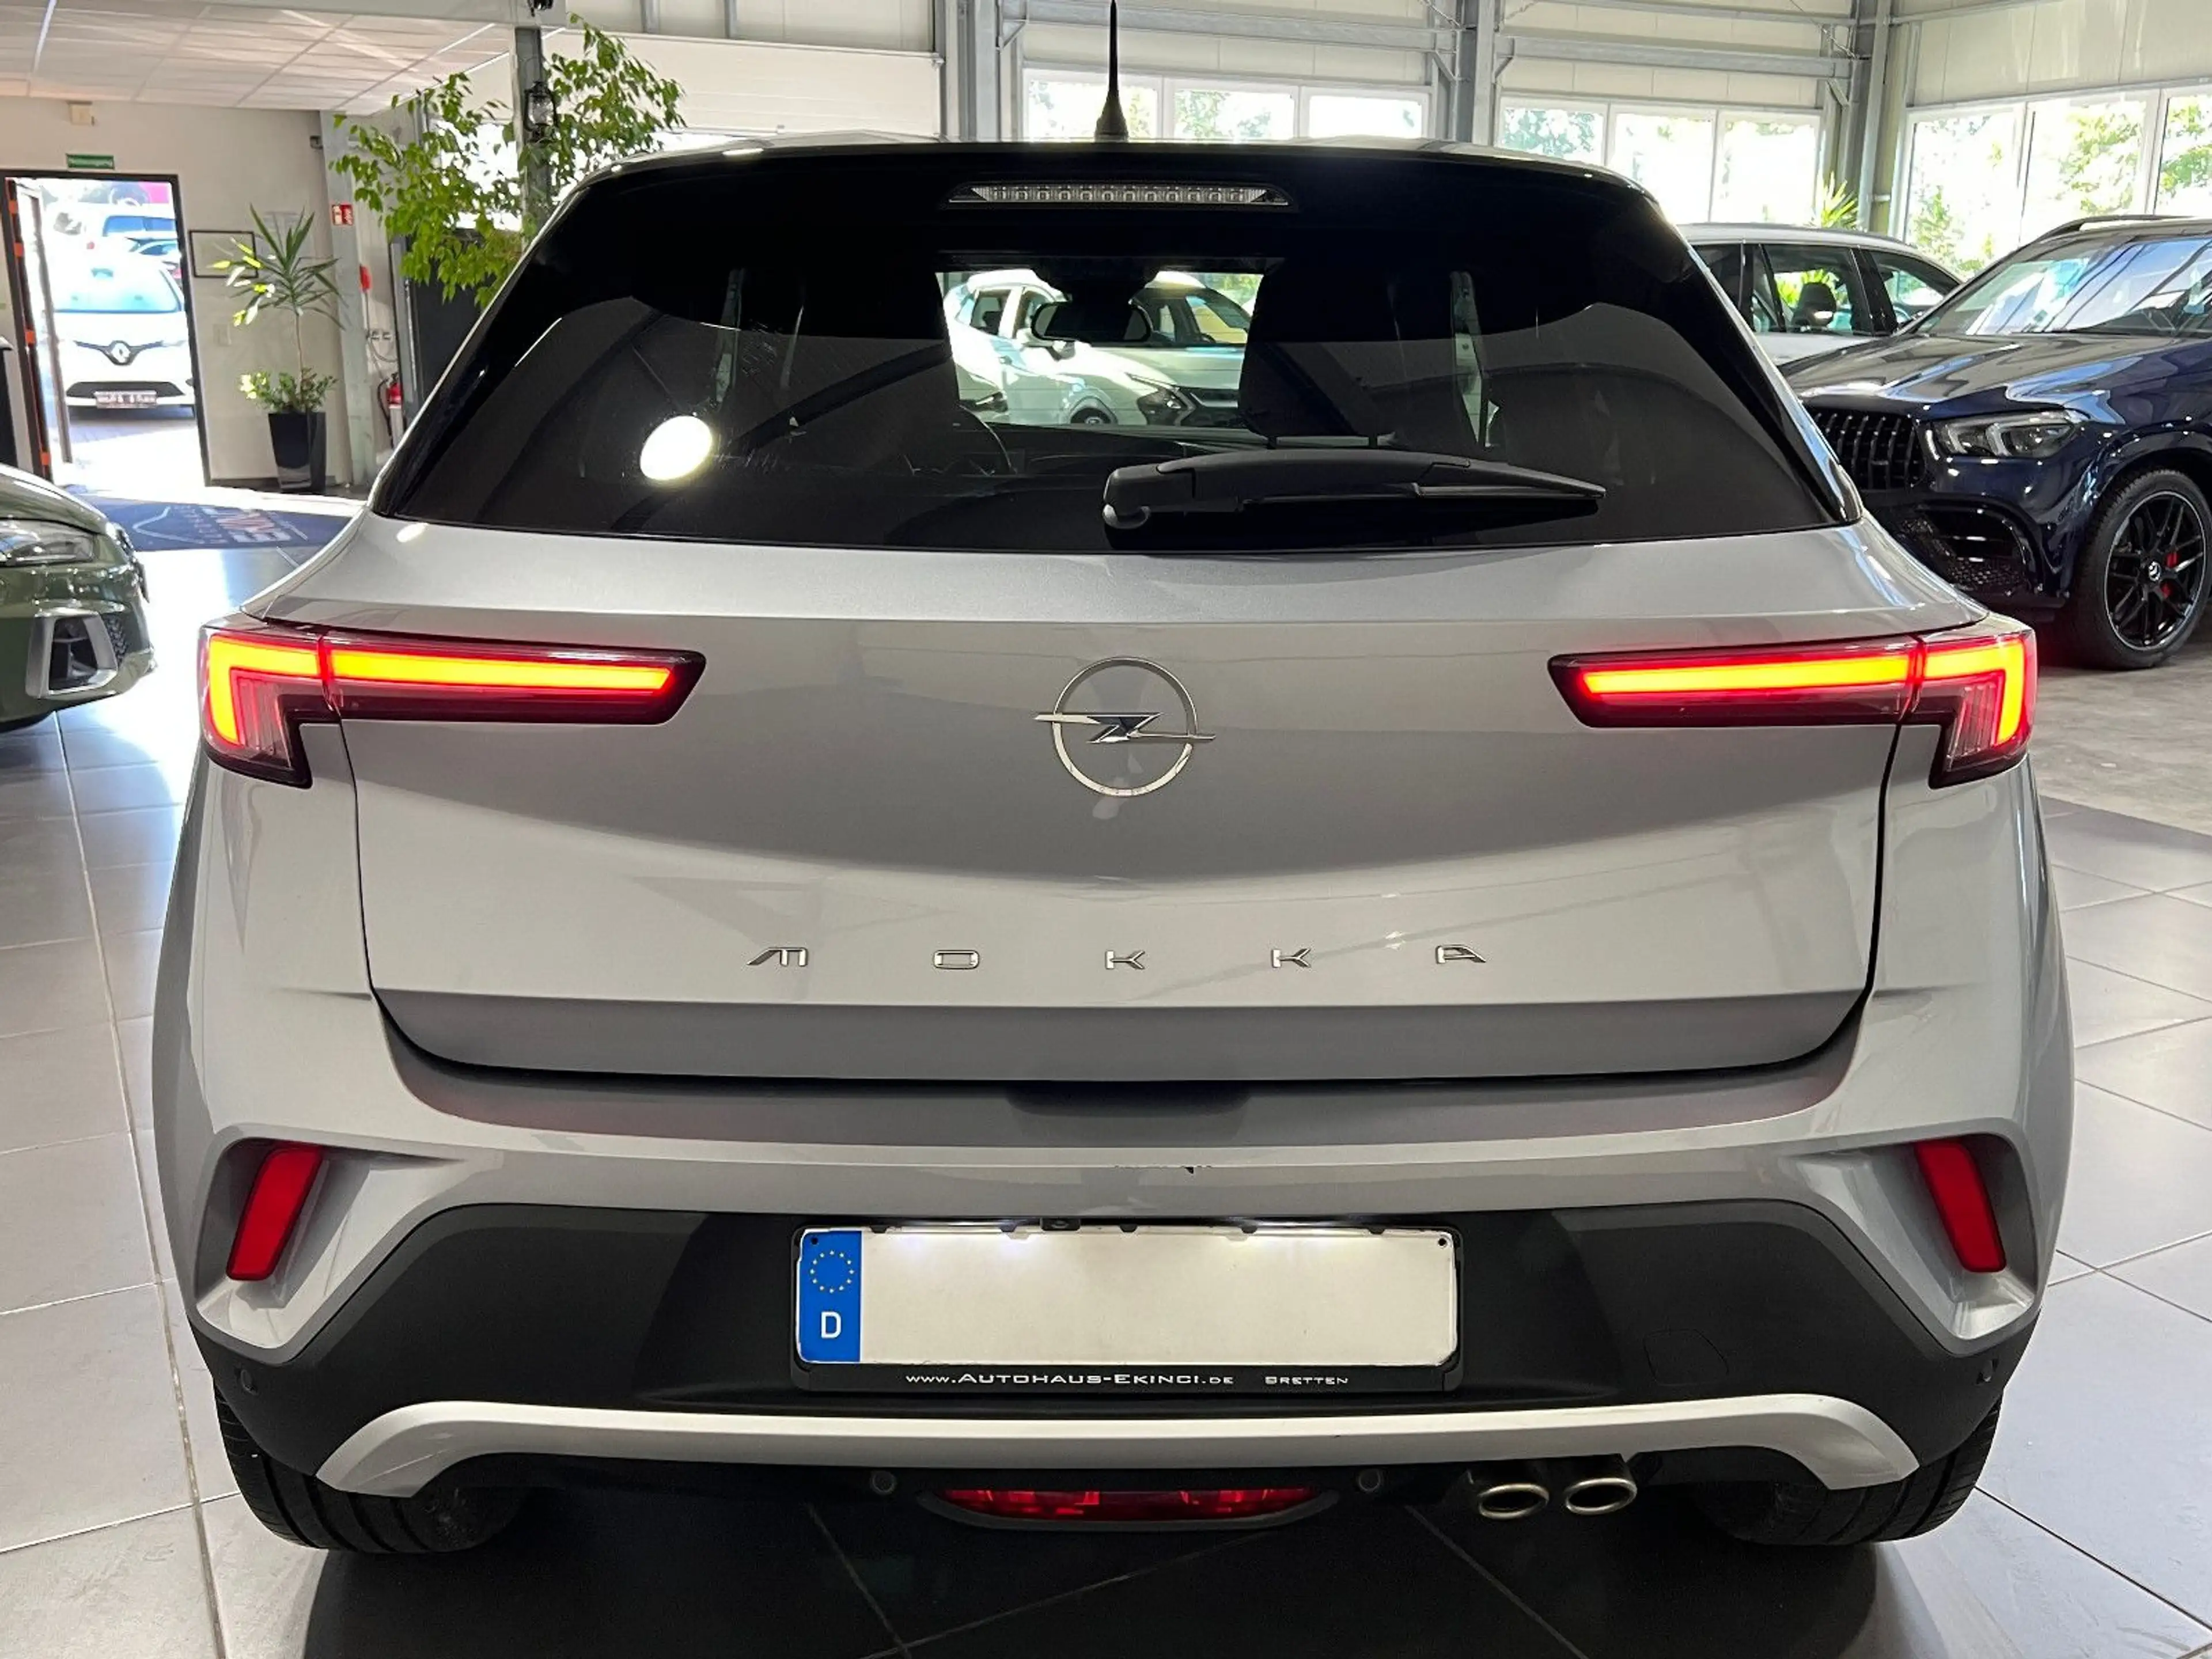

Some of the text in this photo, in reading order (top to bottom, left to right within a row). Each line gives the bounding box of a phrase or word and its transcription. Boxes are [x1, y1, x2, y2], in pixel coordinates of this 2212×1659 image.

[747, 944, 1486, 970] MOKKA
[821, 1311, 841, 1339] D
[1265, 1376, 1349, 1385] BRETTEN
